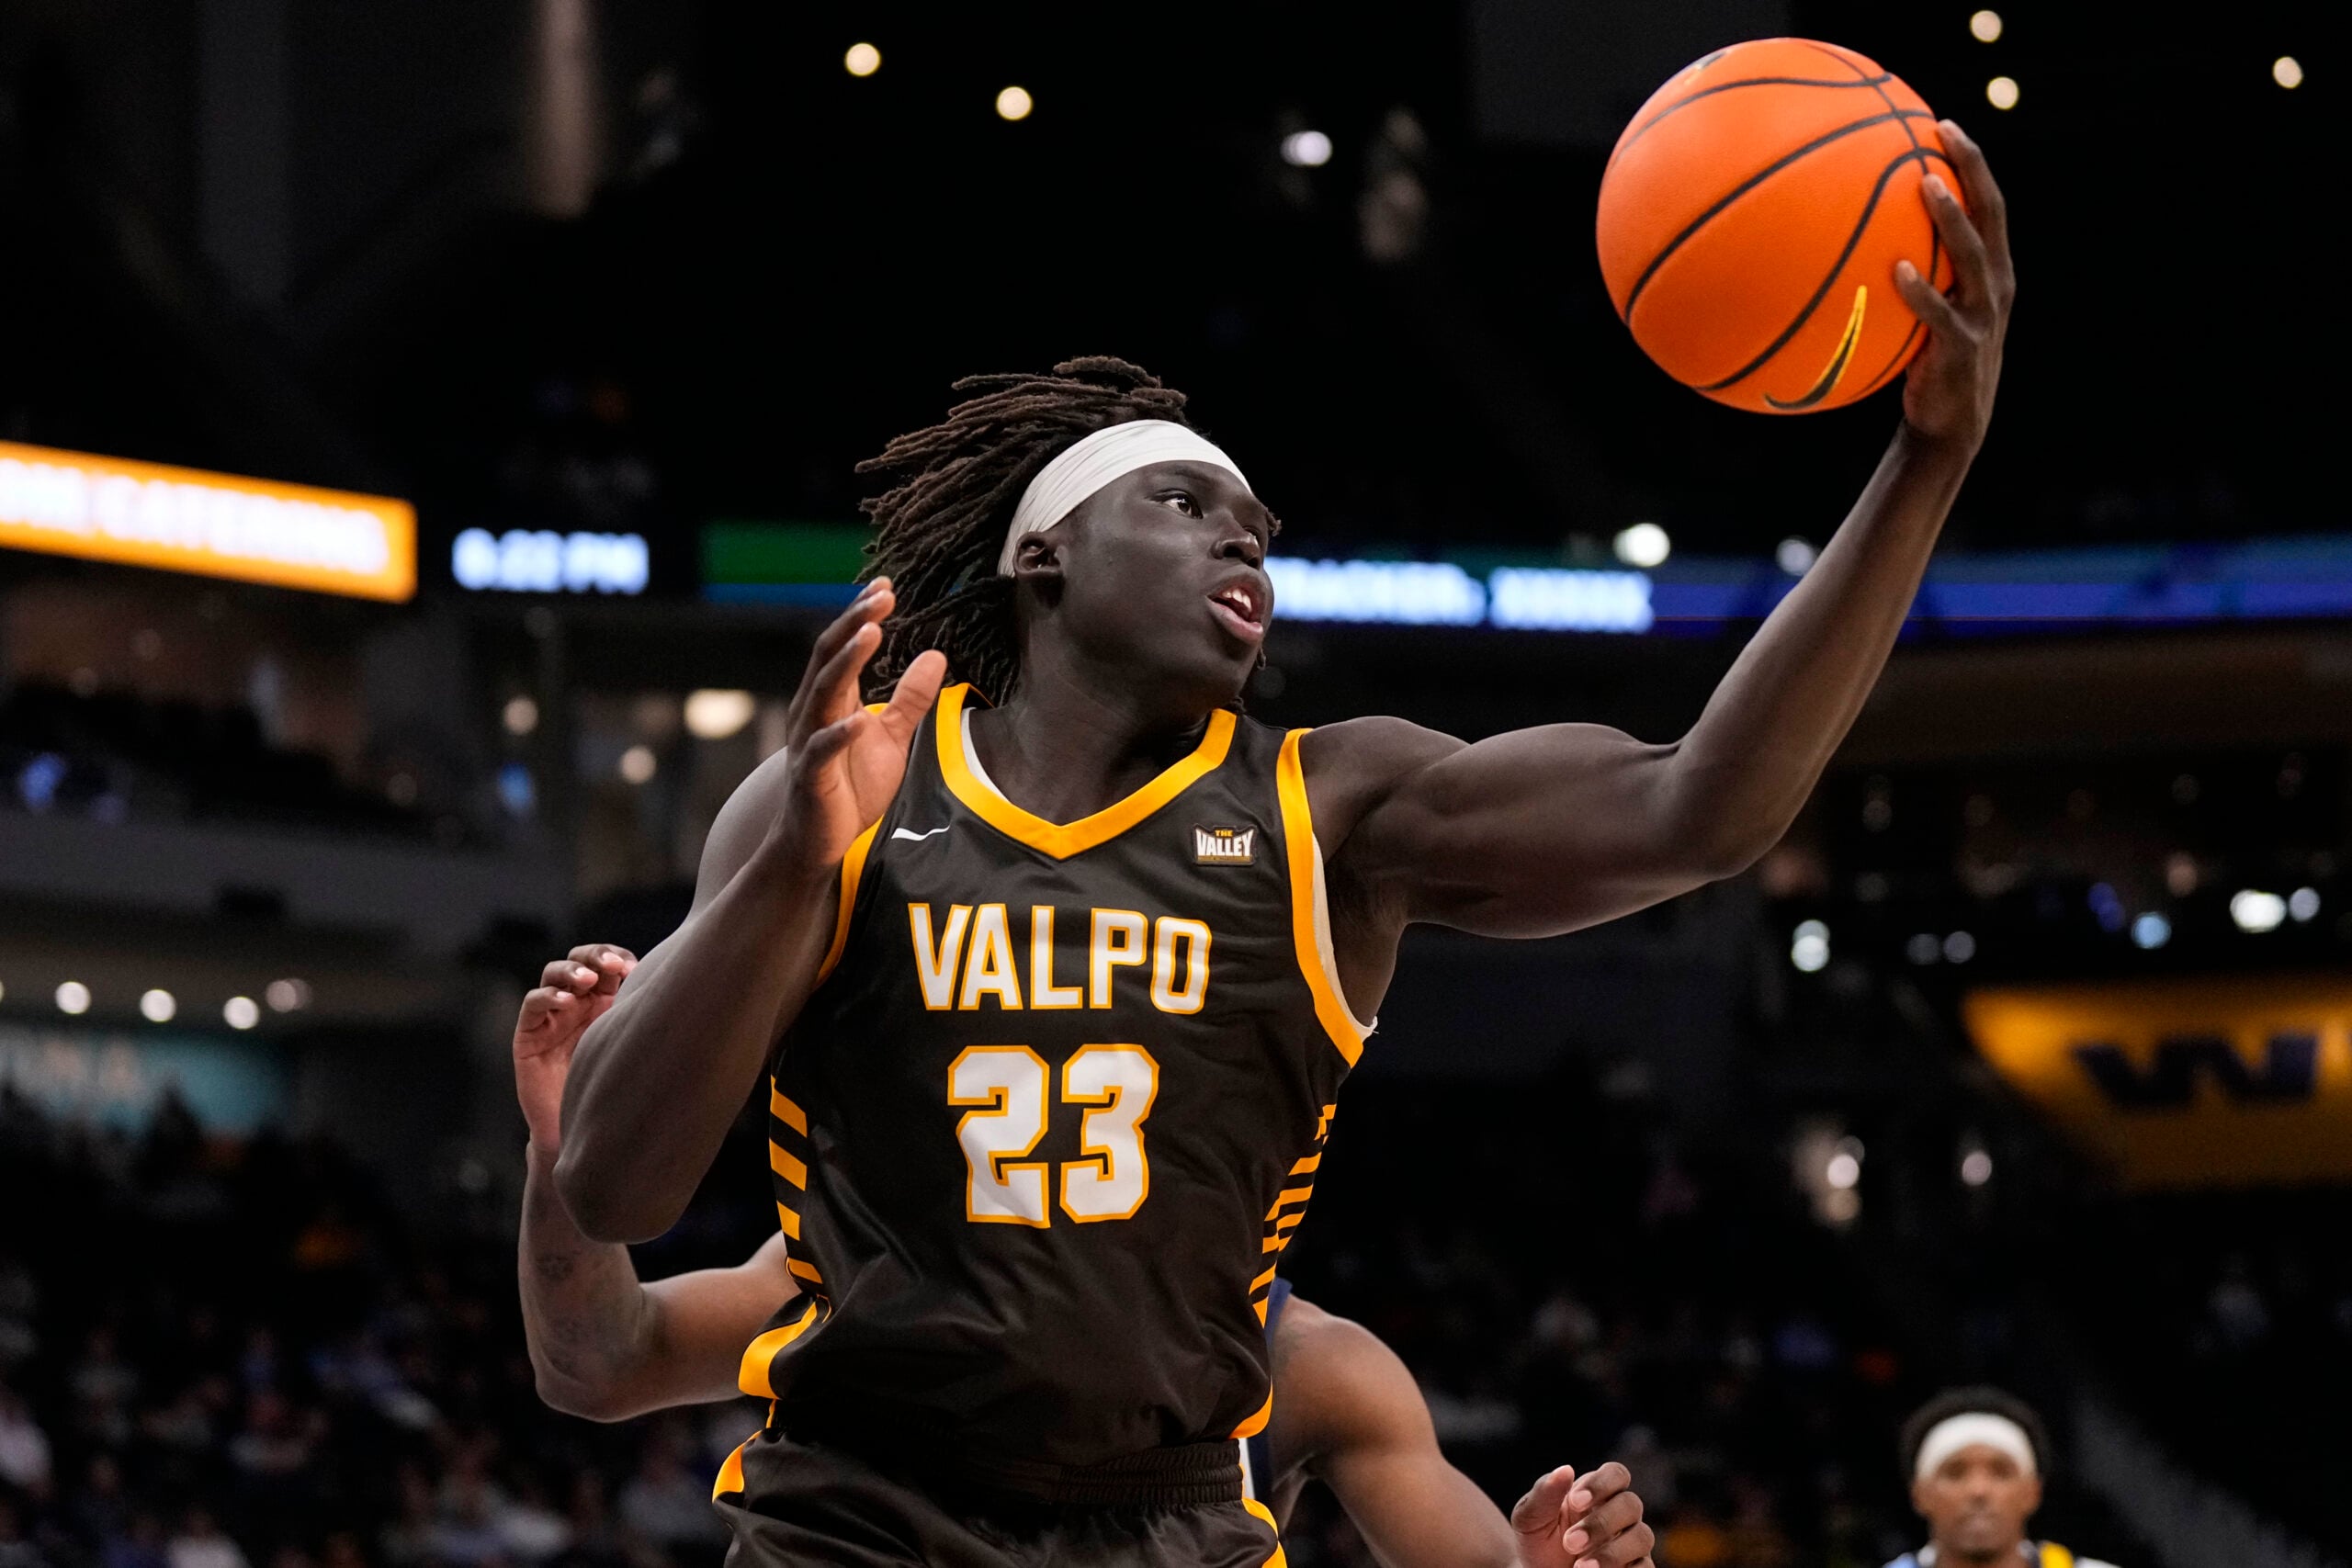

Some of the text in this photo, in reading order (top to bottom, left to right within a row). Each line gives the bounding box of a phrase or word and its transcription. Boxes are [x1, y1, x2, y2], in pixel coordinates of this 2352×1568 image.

[1195, 829, 1254, 856] VALLEY
[908, 903, 1212, 1015] VALPO
[947, 1043, 1160, 1228] 23
